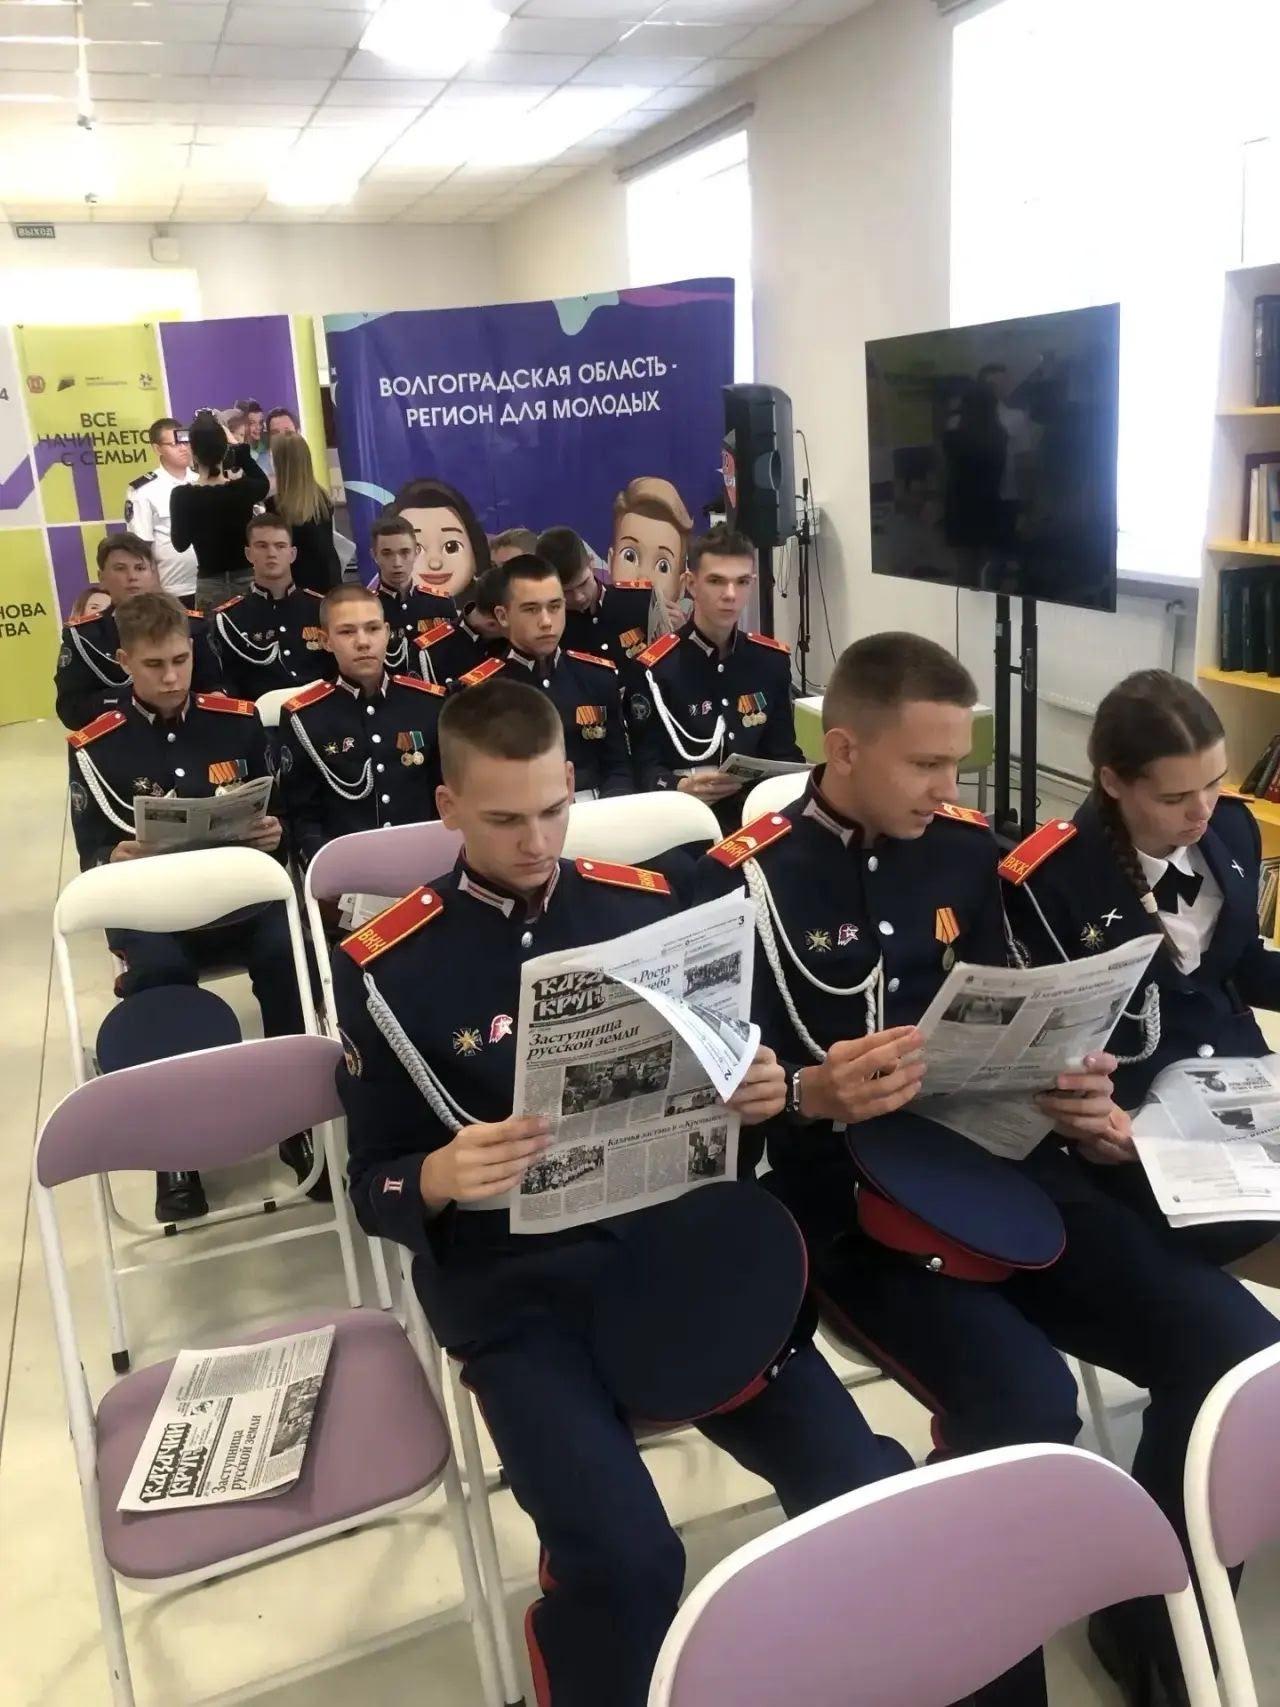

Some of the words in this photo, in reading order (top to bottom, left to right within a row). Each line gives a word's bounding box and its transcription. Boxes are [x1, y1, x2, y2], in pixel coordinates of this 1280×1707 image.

[18, 227, 53, 237] ВЫХОД
[379, 364, 571, 397] ВОЛГОГРАДСКАЯ
[578, 355, 667, 383] ОБЛАСТЬ
[80, 411, 118, 428] ВСЕ
[406, 403, 493, 428] РЕГИОН
[499, 399, 547, 426] ДЛЯ
[553, 390, 661, 419] МОЛОДЫХ
[38, 429, 150, 449] НАЧИНАЕТС
[61, 453, 74, 467] С
[80, 448, 147, 466] СЕМЬИ
[526, 1037, 593, 1062] русской
[596, 1024, 641, 1047] земли
[528, 1017, 622, 1046] Заступница
[212, 1428, 245, 1495] Заступница
[231, 1445, 253, 1491] русской
[246, 1415, 262, 1449] земли
